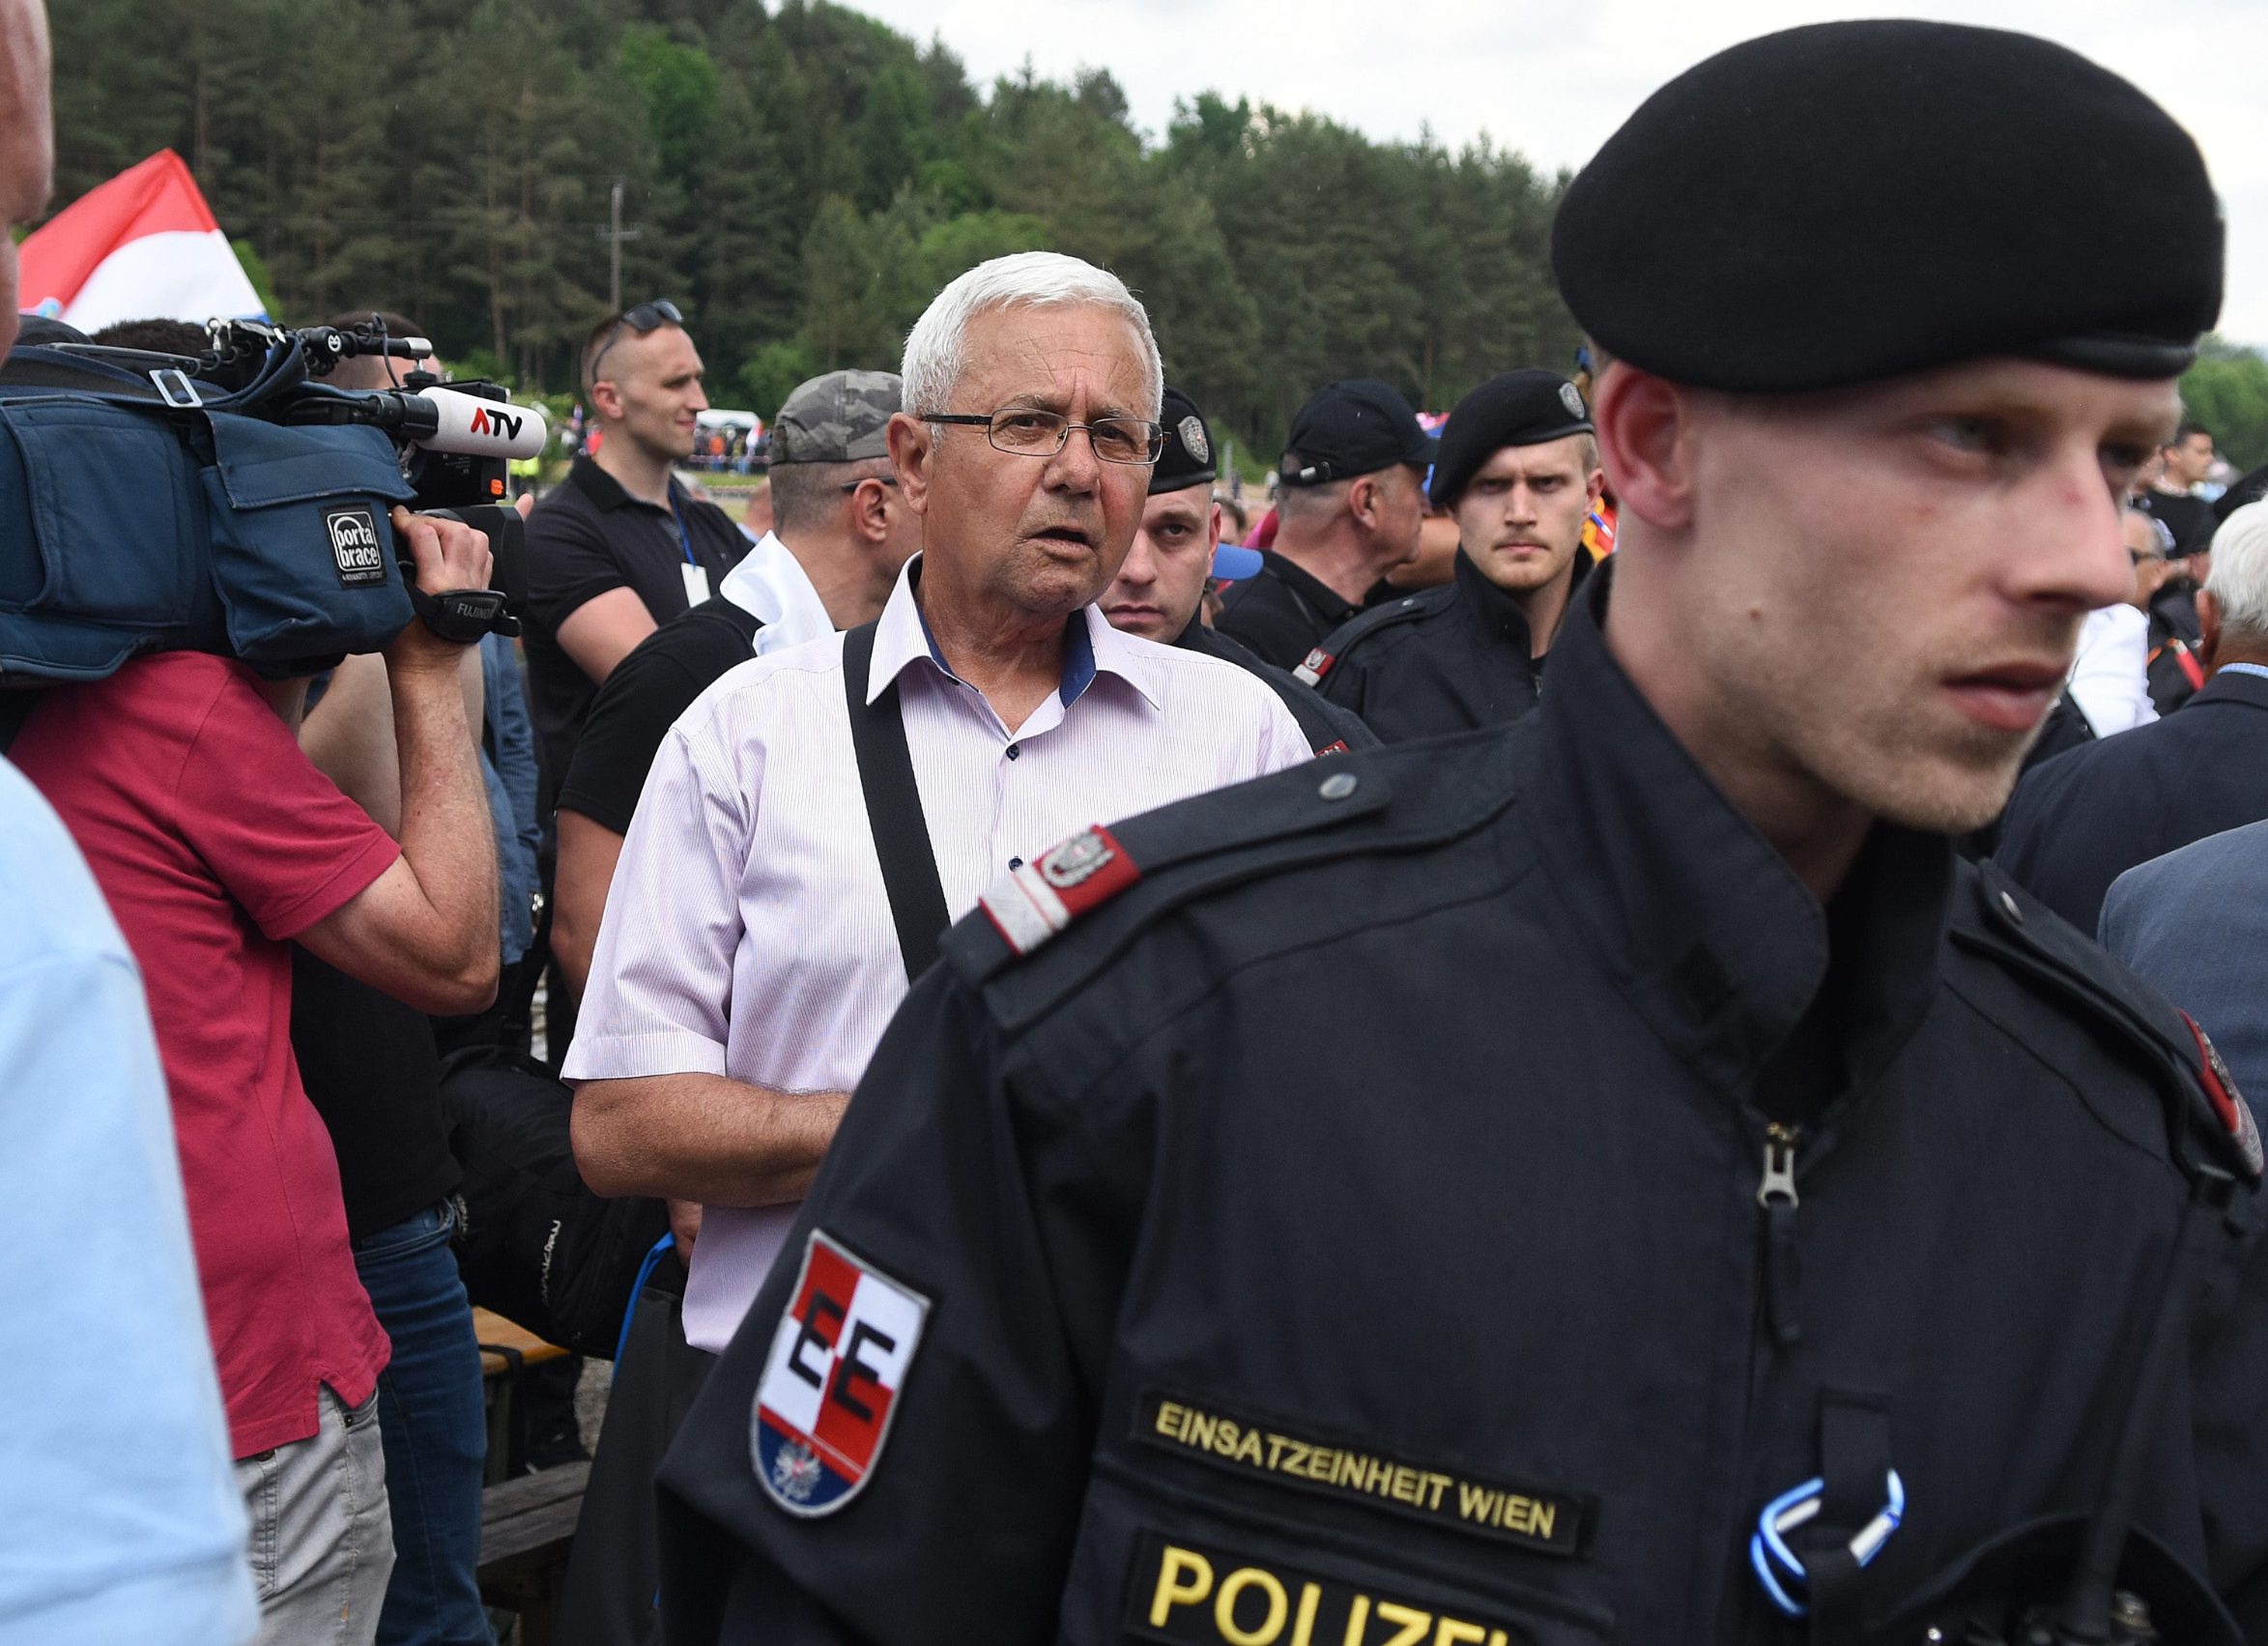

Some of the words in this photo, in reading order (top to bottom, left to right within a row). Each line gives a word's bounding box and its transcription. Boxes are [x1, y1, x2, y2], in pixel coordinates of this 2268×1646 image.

[471, 407, 523, 441] ATV
[334, 527, 374, 548] porta
[338, 546, 379, 567] brace
[1155, 1401, 1453, 1512] EINSATZEINHEIT
[1458, 1482, 1556, 1540] WIEN
[1149, 1545, 1508, 1646] POLIZ
